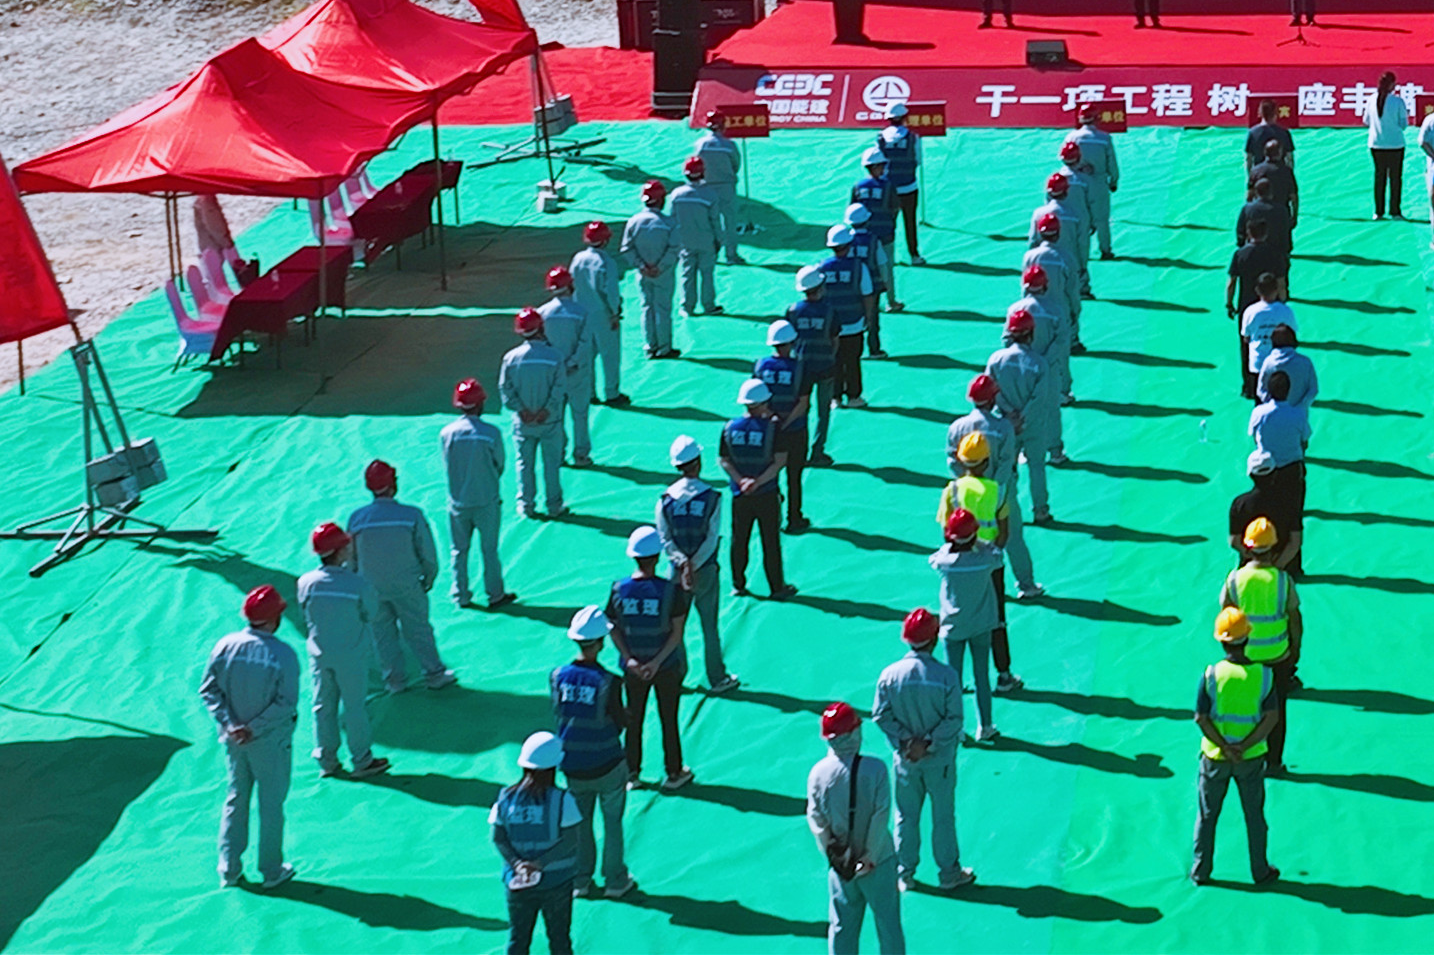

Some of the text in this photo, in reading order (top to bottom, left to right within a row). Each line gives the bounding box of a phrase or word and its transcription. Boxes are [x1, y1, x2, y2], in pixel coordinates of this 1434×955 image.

[975, 83, 1193, 118] 干一项工程
[904, 114, 944, 127] 理单位
[1099, 110, 1125, 123] 单位
[622, 598, 659, 616] 监理
